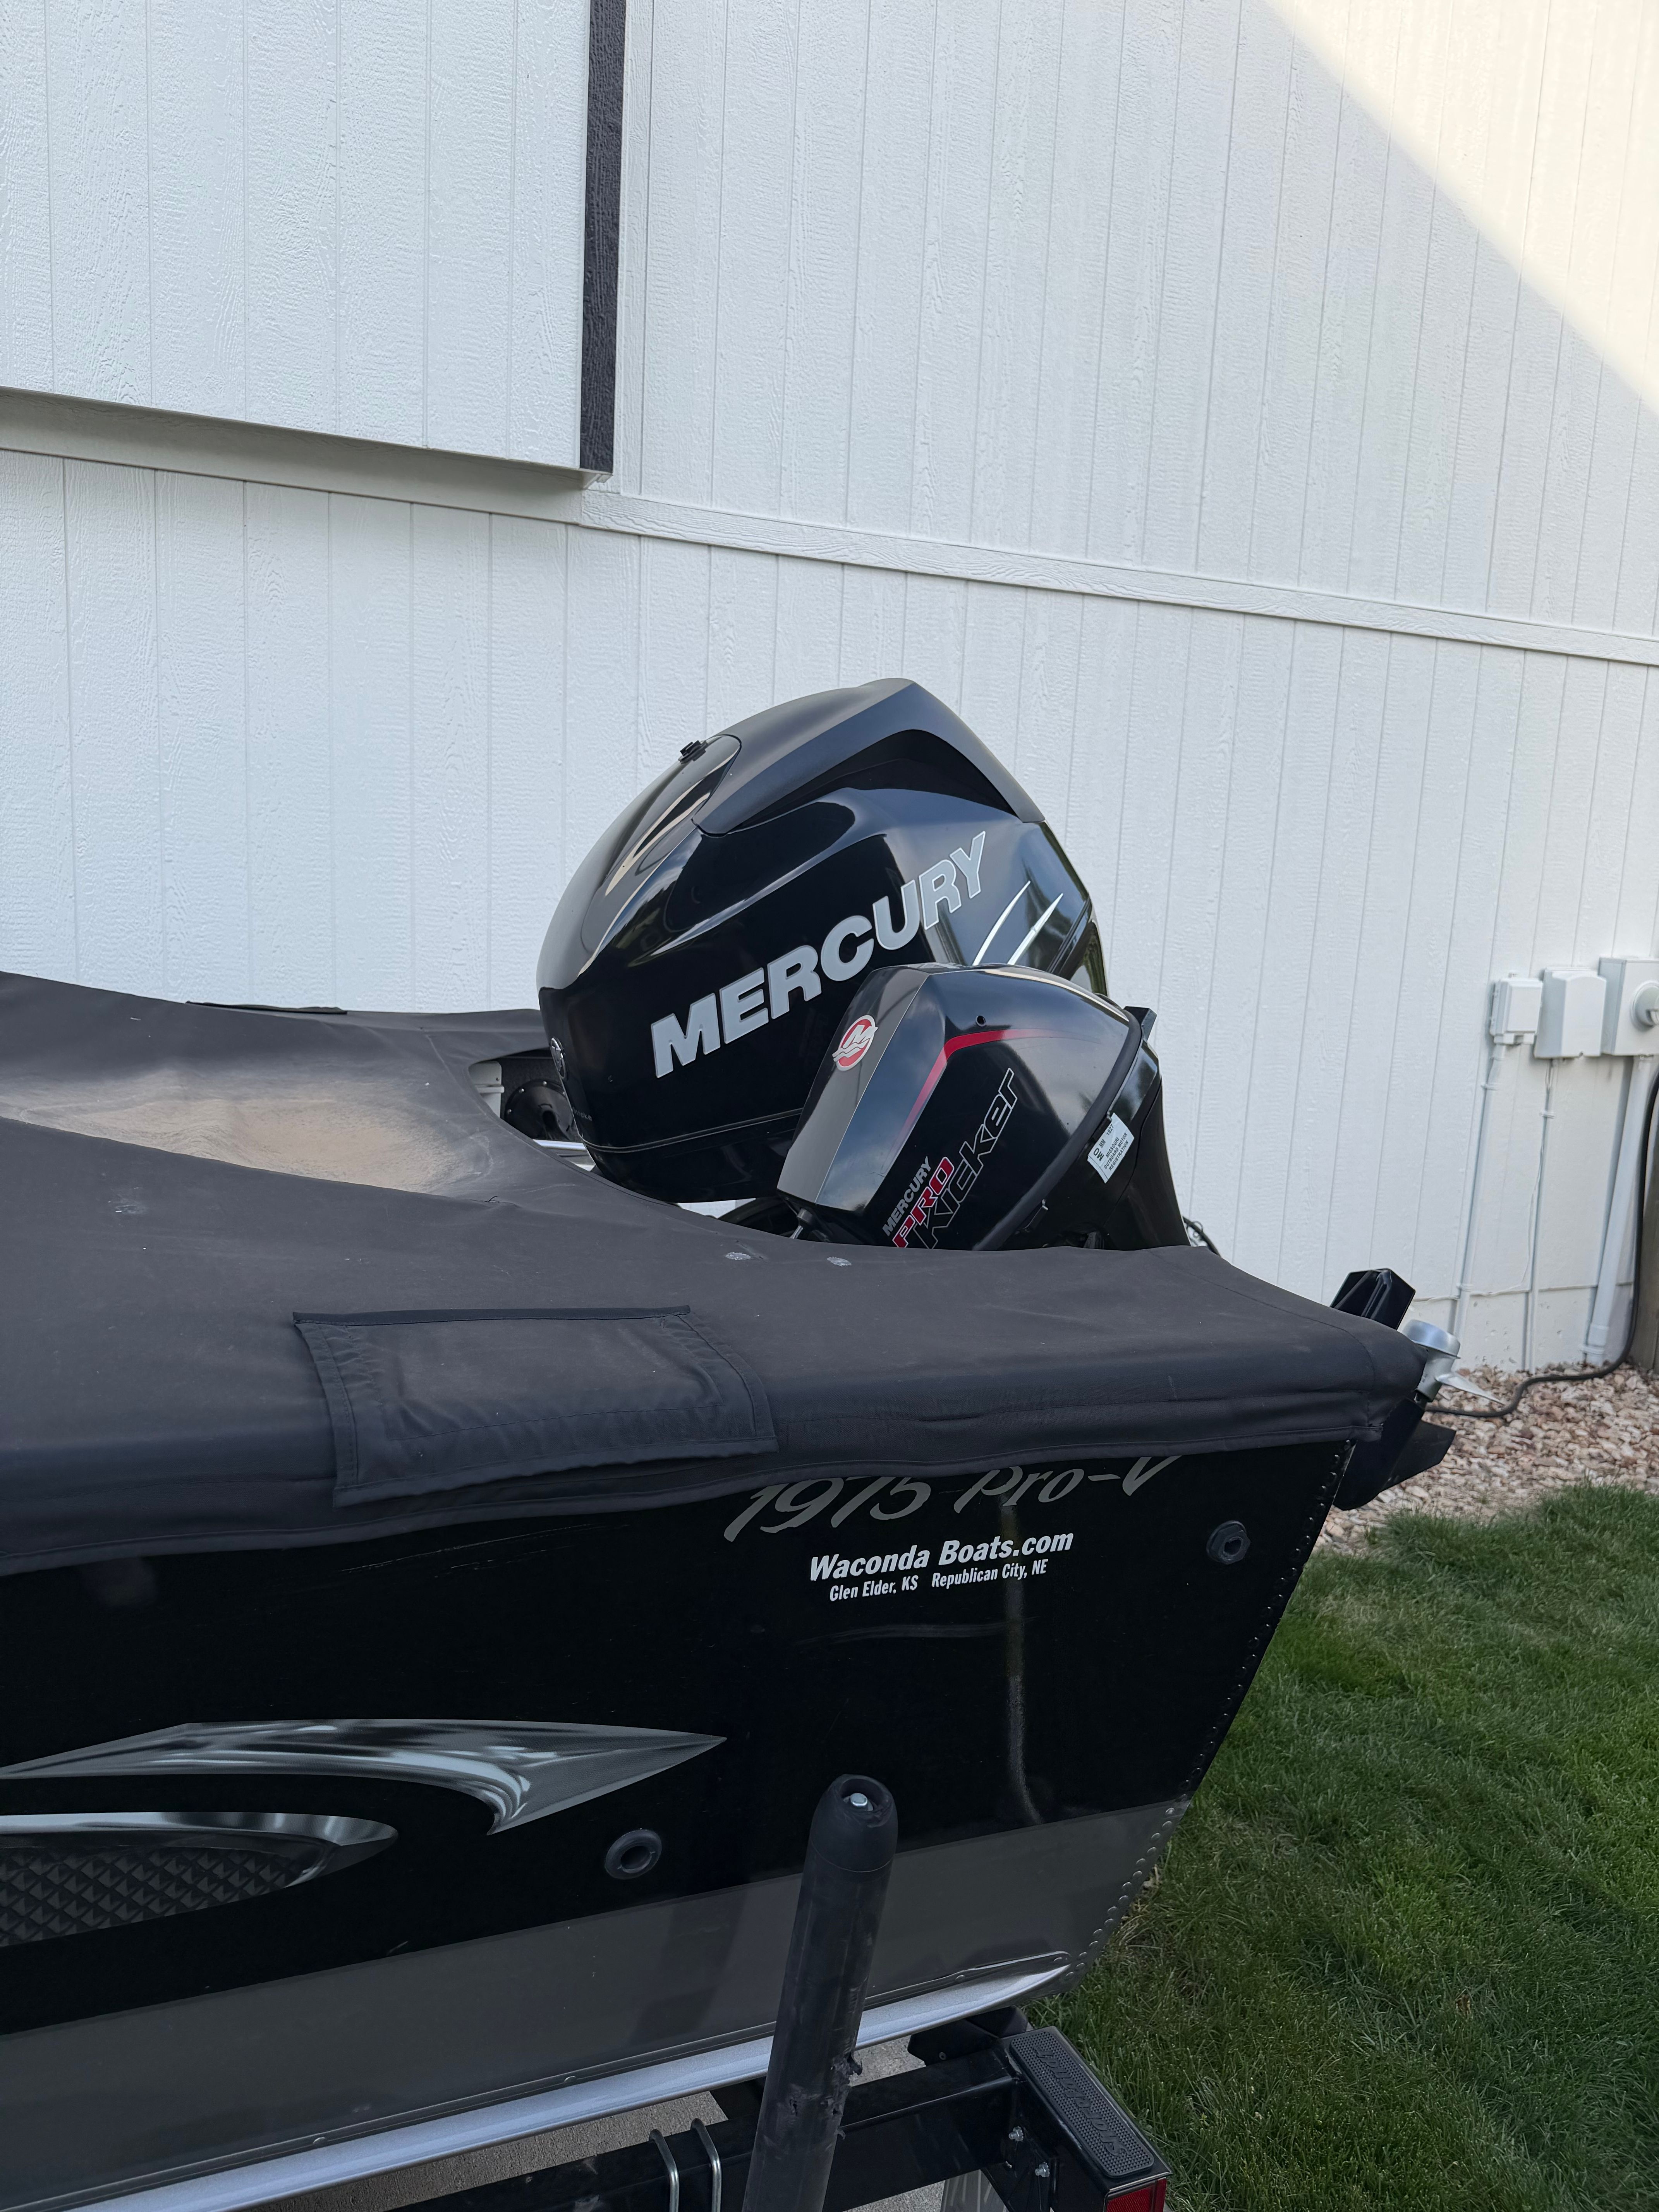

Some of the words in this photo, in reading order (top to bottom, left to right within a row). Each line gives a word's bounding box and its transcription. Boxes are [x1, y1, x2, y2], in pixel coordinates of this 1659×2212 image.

[651, 831, 986, 1078] MERCURY
[1093, 1147, 1104, 1161] MO
[1104, 1148, 1119, 1169] OUTBOARD
[1118, 1132, 1128, 1148] MOTOR
[1106, 1137, 1120, 1158] MISSOURI
[1109, 1140, 1128, 1171] REGISTRATION
[882, 1156, 931, 1237] MERCURY
[892, 1156, 955, 1248] PRO
[724, 1476, 931, 1542] 1975
[953, 1456, 1182, 1513] Pro-V
[810, 1545, 930, 1581] Waconda
[938, 1533, 1073, 1565] Boats.com
[931, 1568, 998, 1589] Republican
[1001, 1562, 1027, 1580] City,
[1031, 1559, 1048, 1574] NE
[830, 1585, 858, 1601] Glen
[902, 1575, 919, 1590] KS
